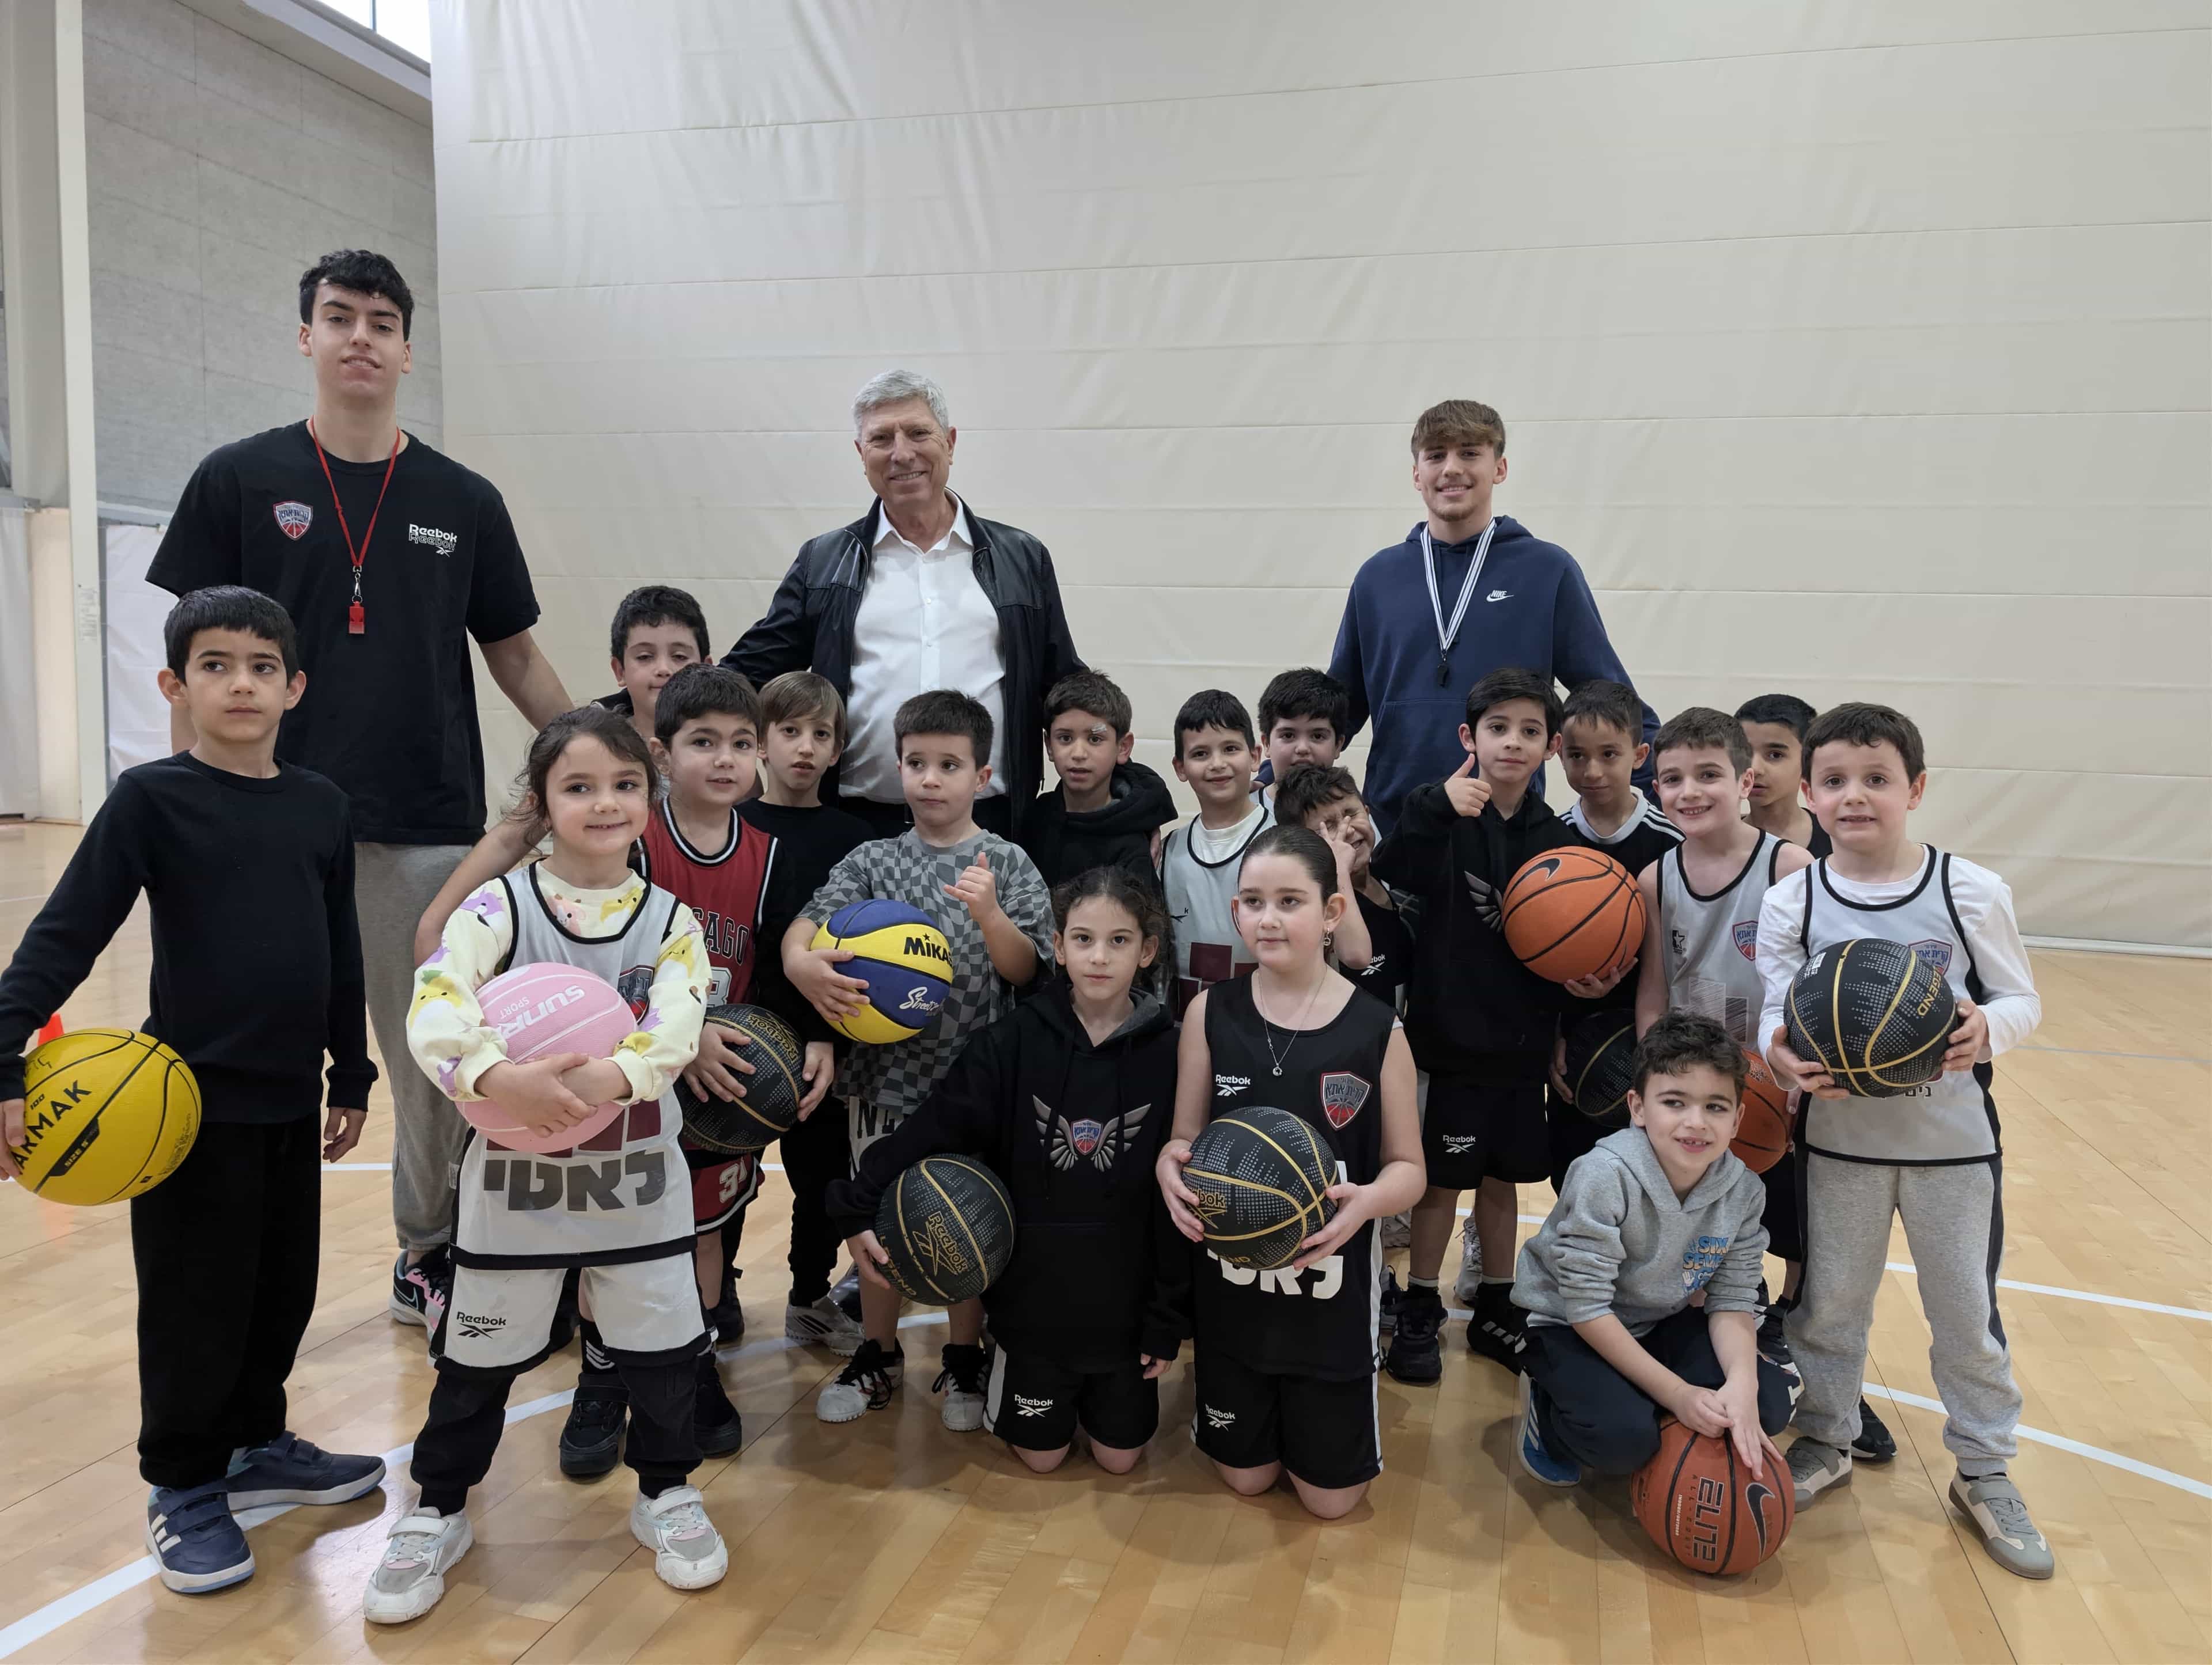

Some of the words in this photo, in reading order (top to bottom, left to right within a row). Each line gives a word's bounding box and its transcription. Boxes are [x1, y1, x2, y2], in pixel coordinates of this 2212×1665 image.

[409, 523, 457, 543] Reebok
[1491, 590, 1508, 598] NIKE
[497, 985, 585, 1039] SUNR
[499, 996, 529, 1019] SPORT
[748, 1013, 799, 1064] Reebok
[1215, 1074, 1251, 1086] Reebok
[12, 1080, 92, 1175] ARMAK
[1443, 1135, 1476, 1143] Reebok
[928, 1211, 968, 1273] Reebok
[1698, 1235, 1729, 1254] SIX
[456, 1311, 507, 1326] Reebok
[1014, 1394, 1054, 1407] Reebok
[1205, 1403, 1236, 1420] Reebok
[1691, 1476, 1725, 1562] ELITE
